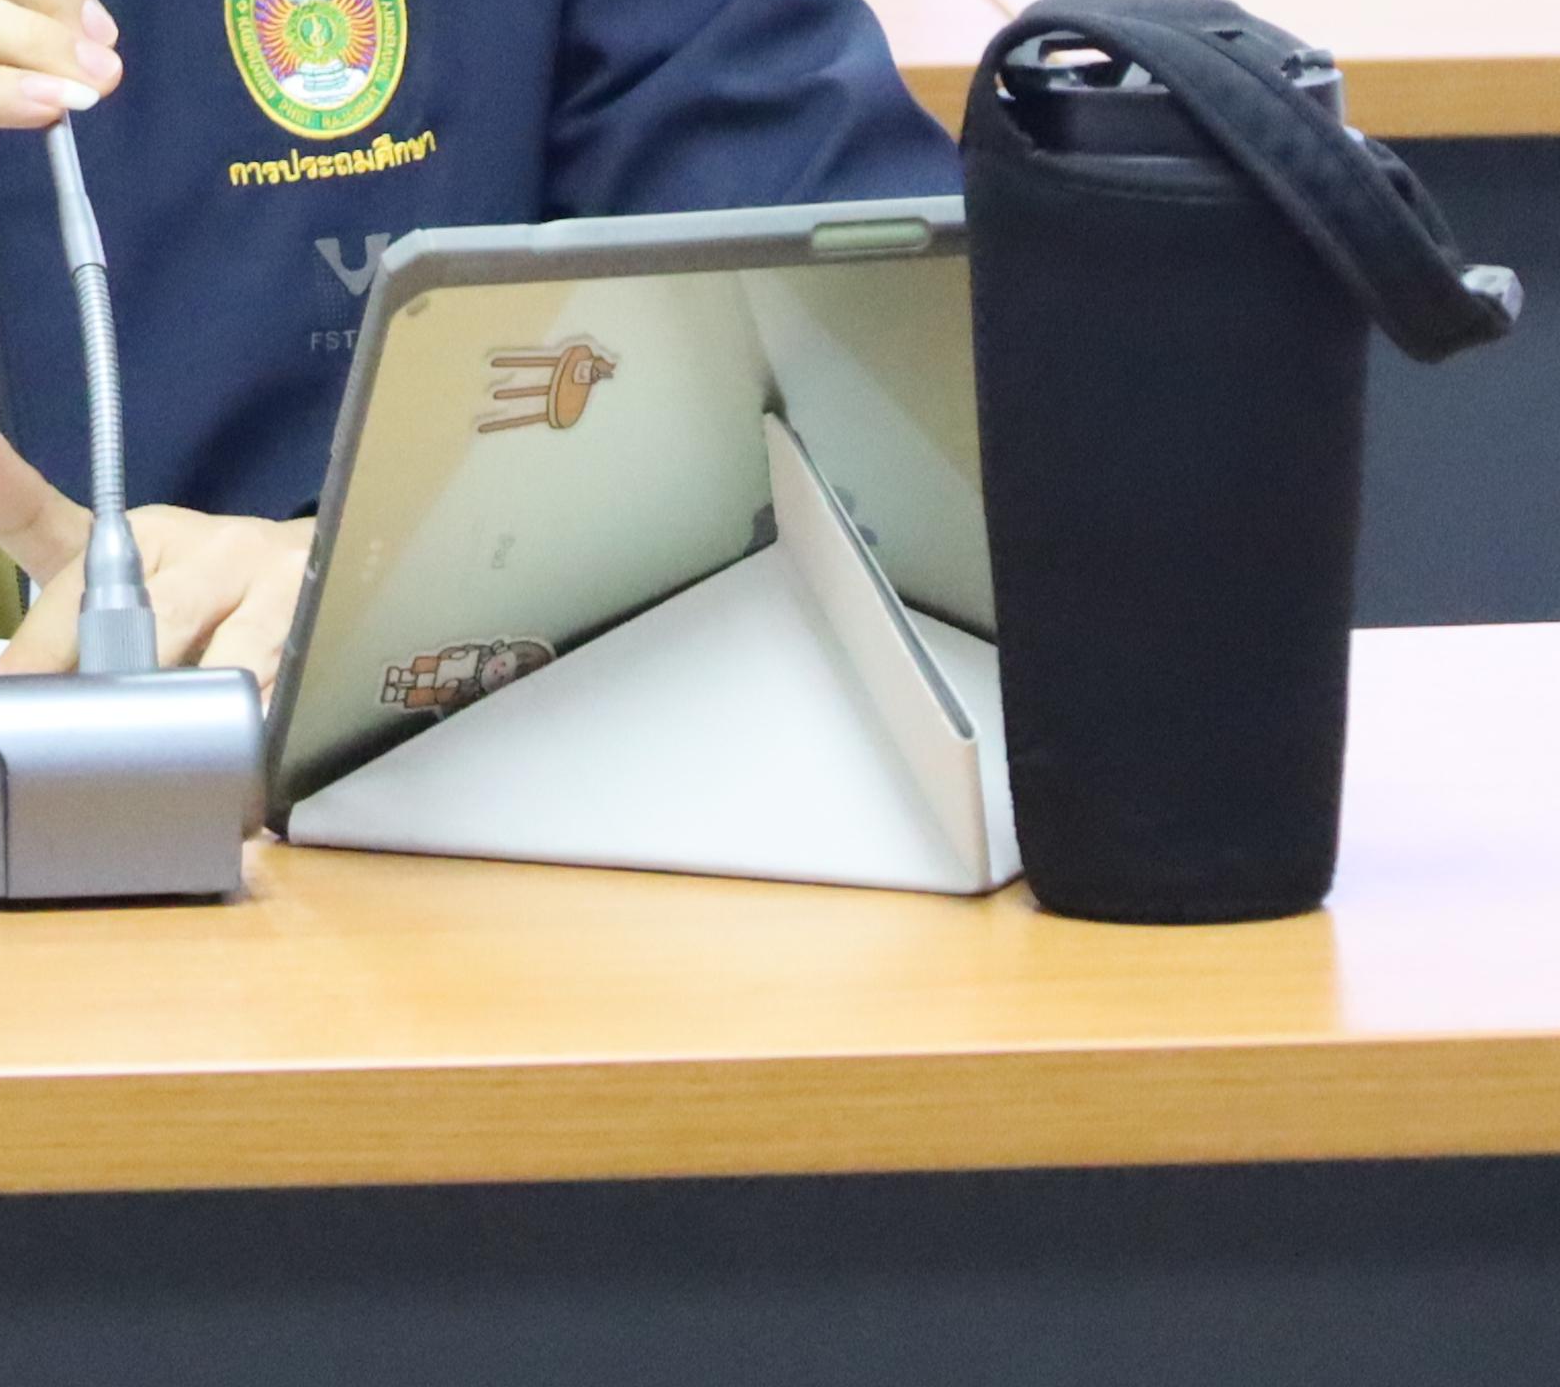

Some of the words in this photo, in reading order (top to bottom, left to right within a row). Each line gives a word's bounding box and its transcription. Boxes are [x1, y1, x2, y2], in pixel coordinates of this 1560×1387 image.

[228, 129, 437, 186] การประถมศึกษา
[310, 329, 358, 351] FST
